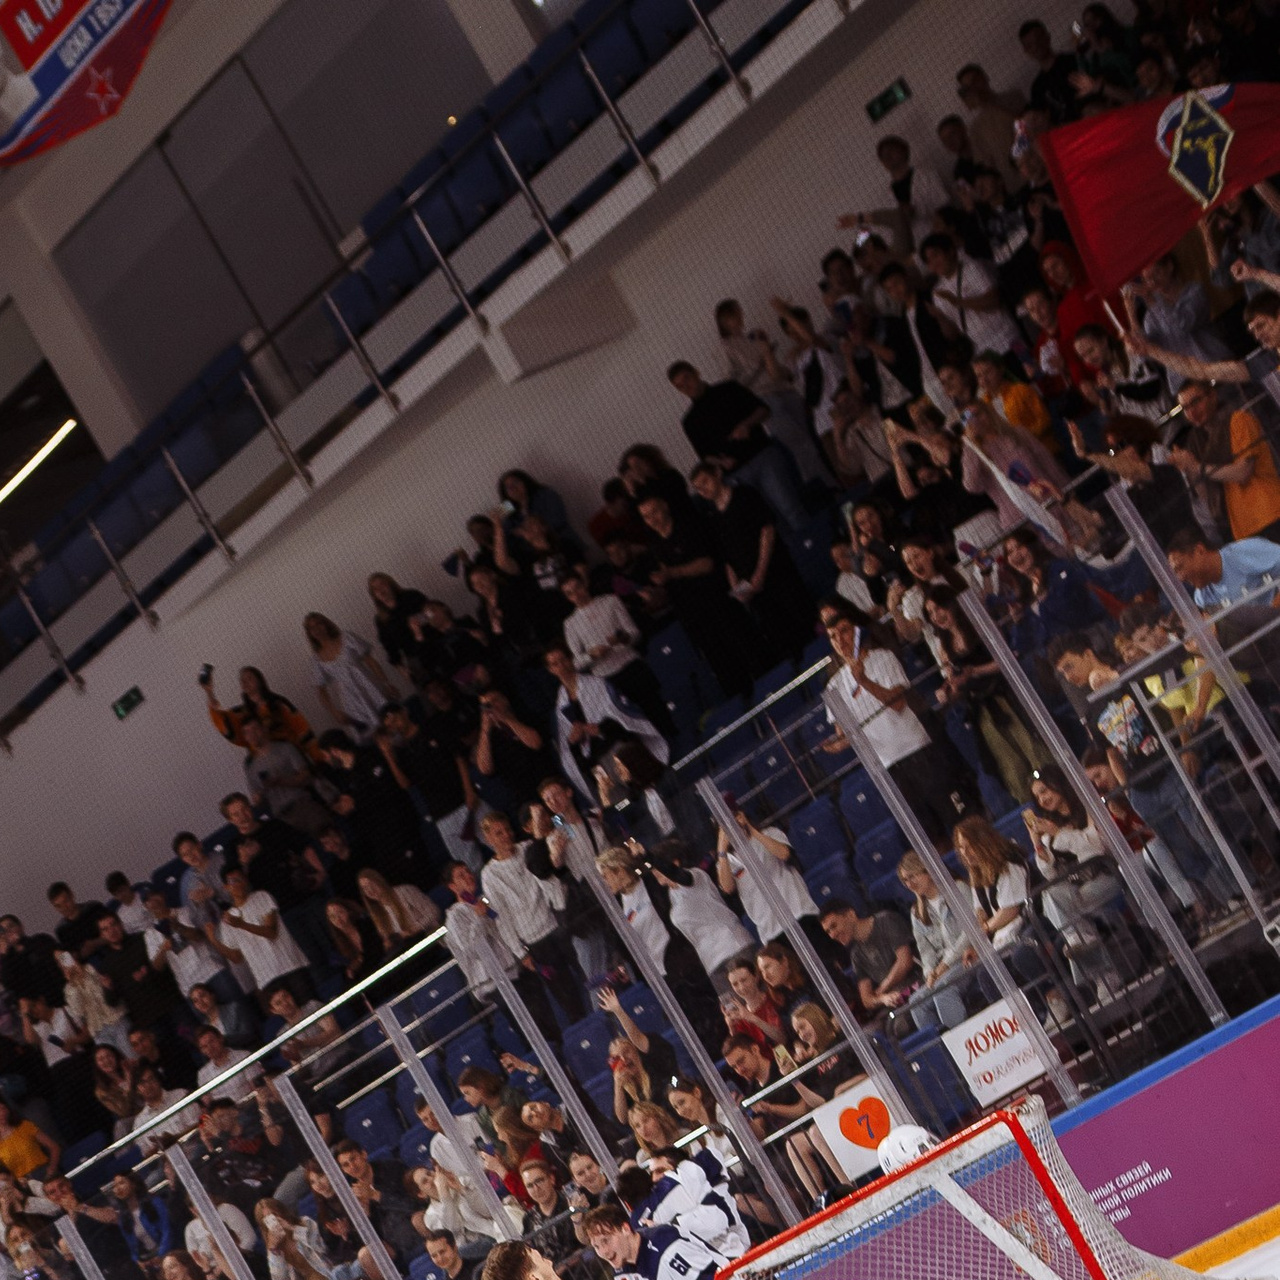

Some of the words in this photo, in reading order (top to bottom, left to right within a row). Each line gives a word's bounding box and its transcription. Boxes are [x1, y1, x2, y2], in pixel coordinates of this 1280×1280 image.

[856, 1112, 876, 1140] 7
[1116, 1160, 1153, 1189] СВЯЗЕЙ
[1121, 1167, 1173, 1202] ПОЛИТИКИ
[669, 1252, 693, 1276] 61
